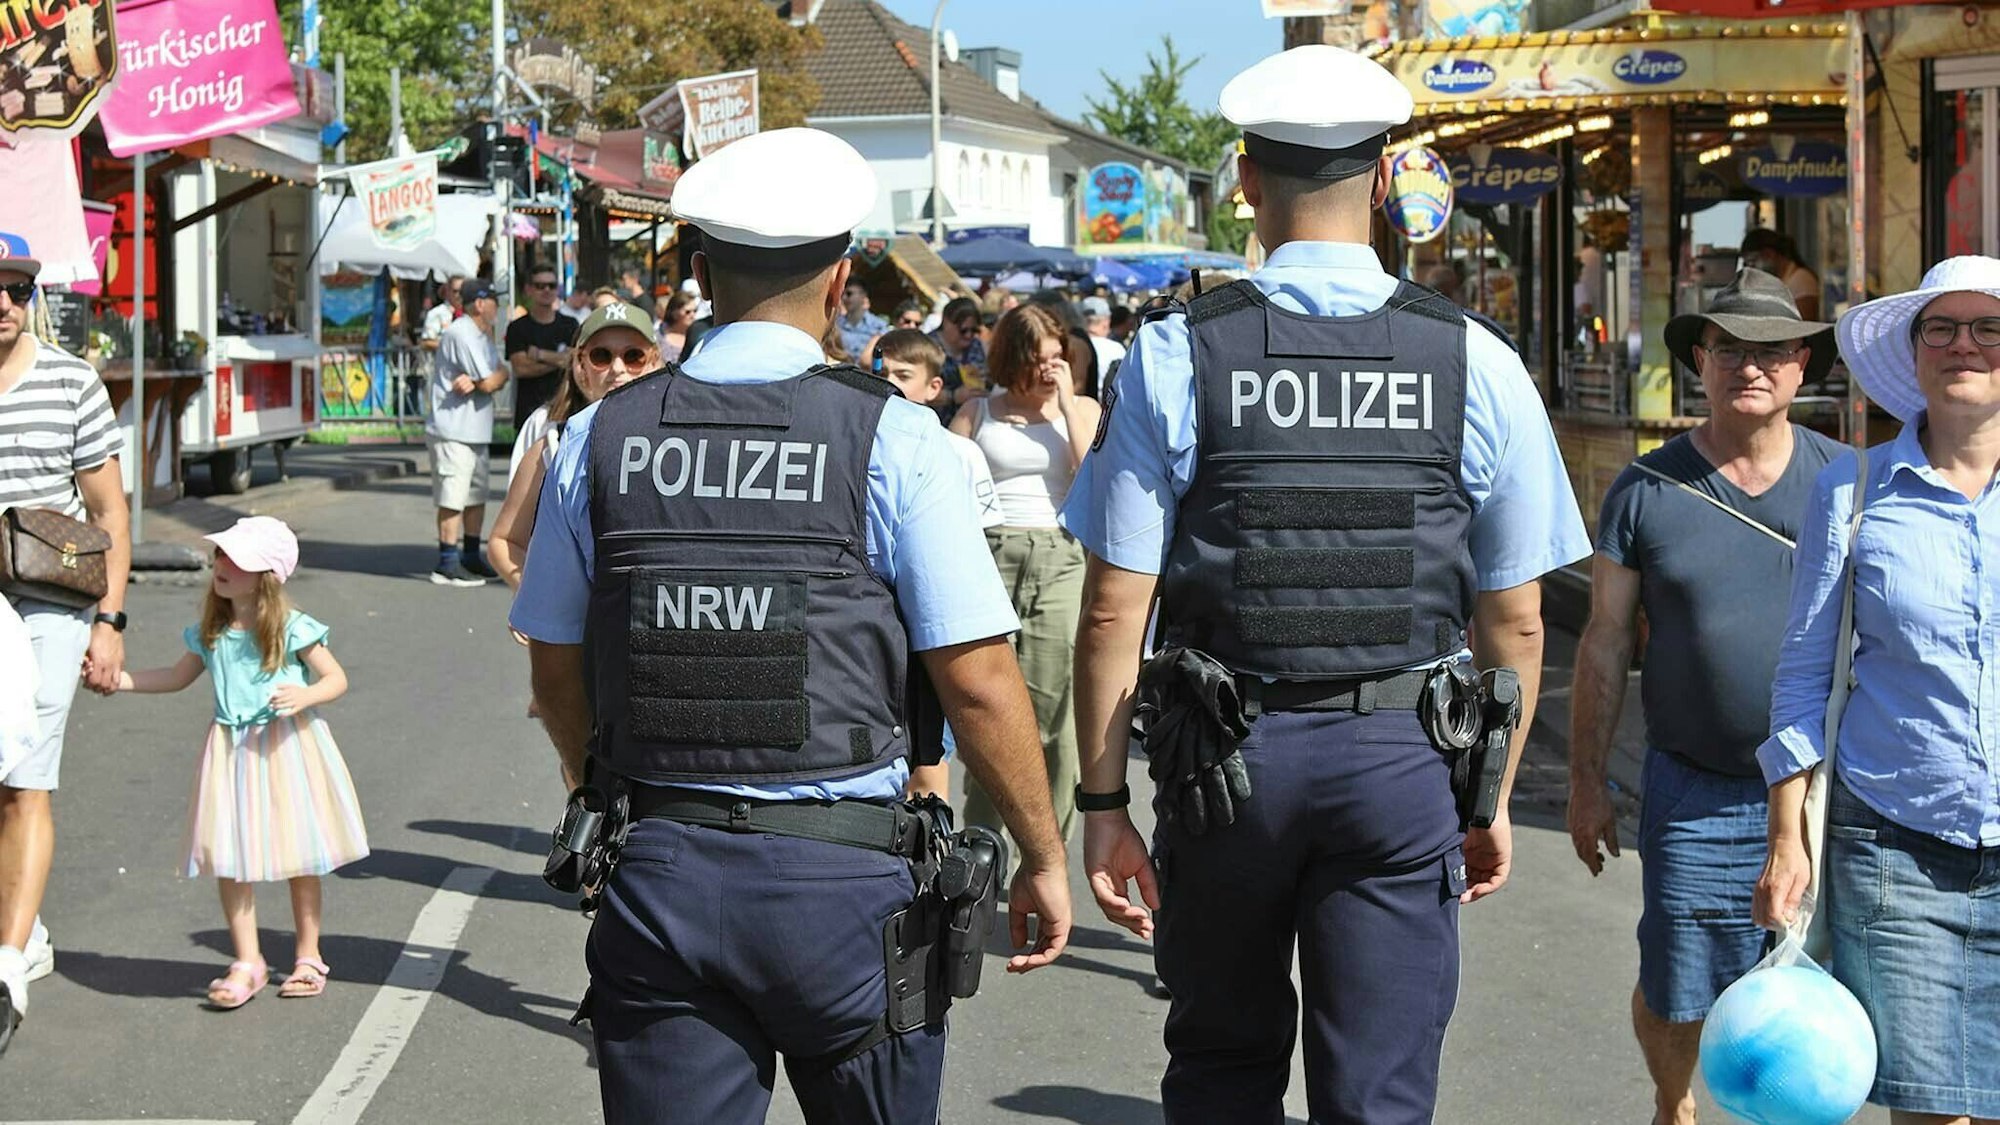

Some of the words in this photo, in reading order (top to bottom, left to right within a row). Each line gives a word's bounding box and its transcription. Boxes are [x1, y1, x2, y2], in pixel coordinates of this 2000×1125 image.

[1613, 58, 1685, 76] Crêpes
[149, 70, 244, 118] Honig
[1450, 164, 1559, 192] Crêpes
[1746, 156, 1848, 183] Dampfnude
[369, 177, 433, 228] LANGOS
[605, 303, 627, 320] NY
[1231, 369, 1433, 430] POLIZEI
[619, 435, 828, 502] POLIZEI
[656, 585, 773, 631] NRW
